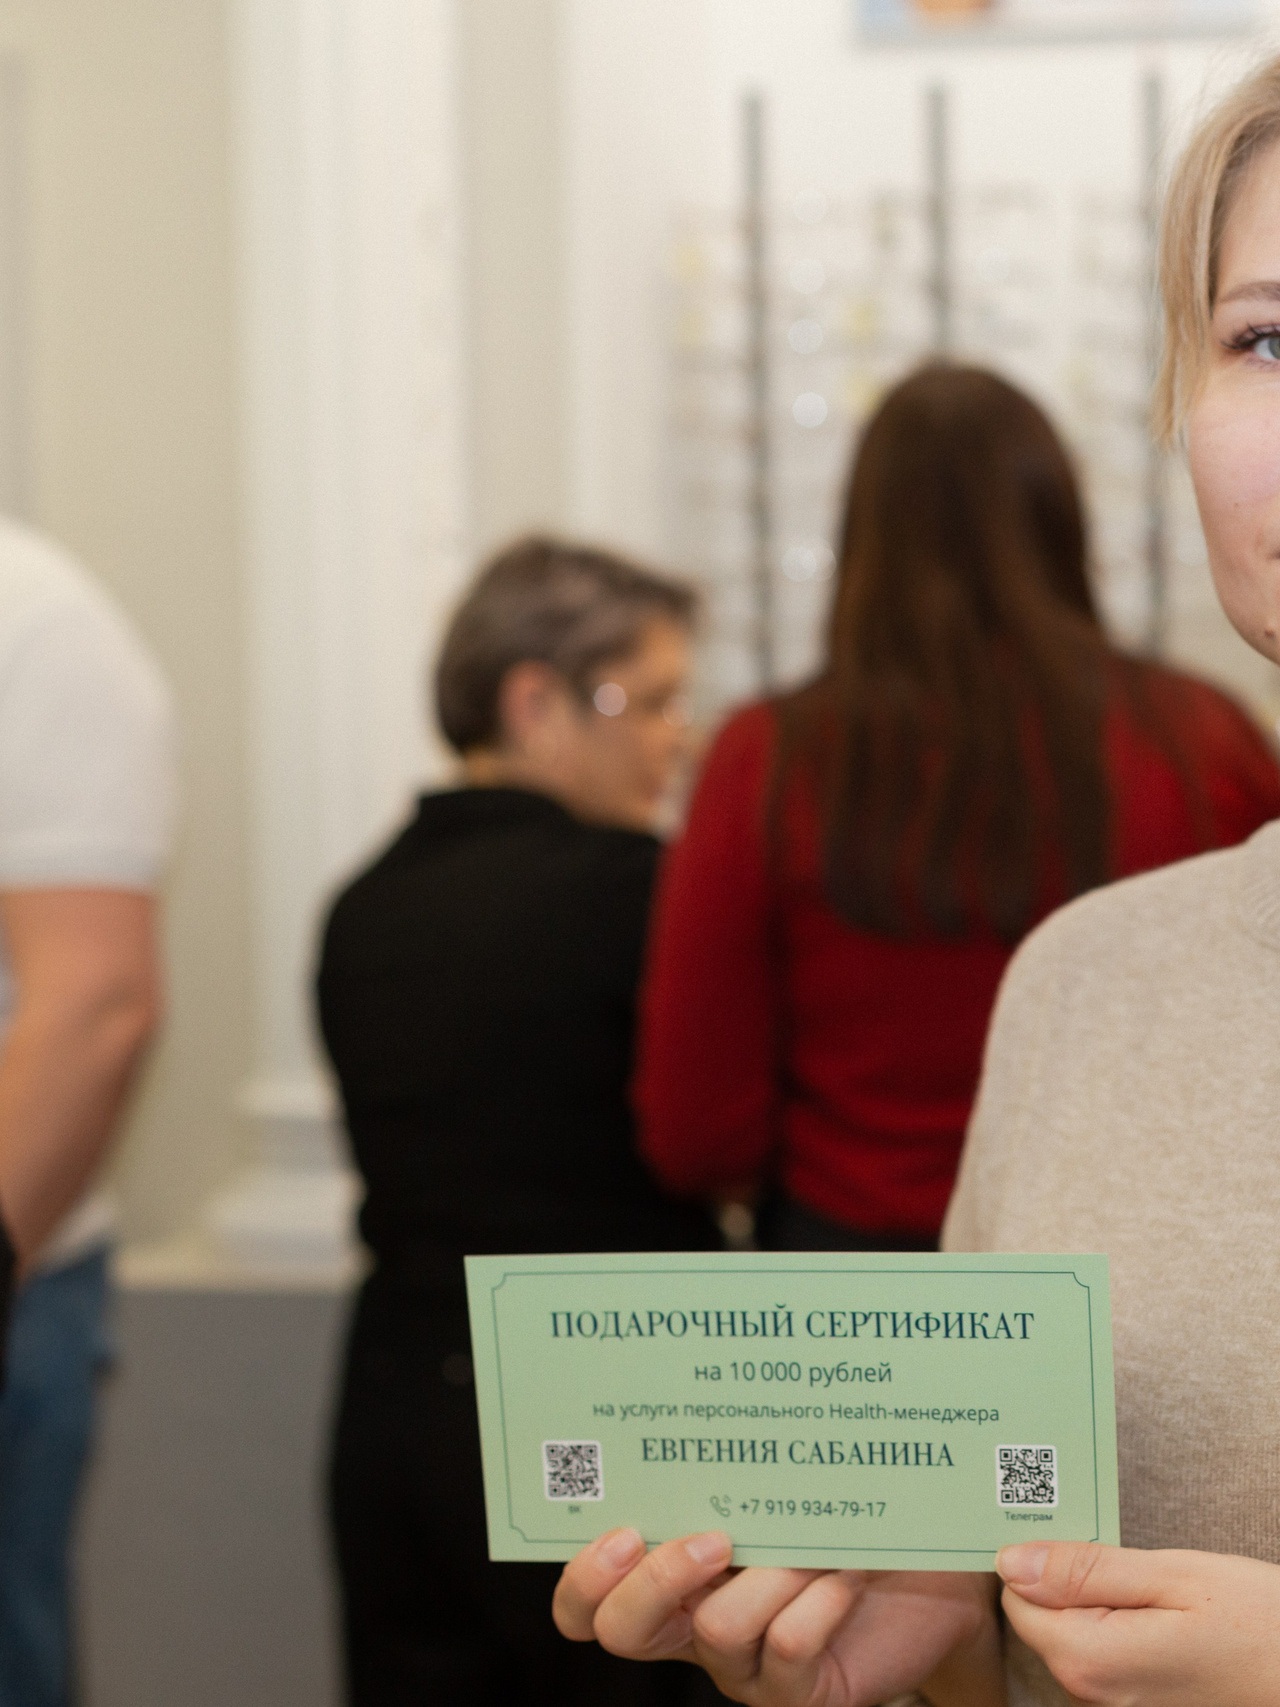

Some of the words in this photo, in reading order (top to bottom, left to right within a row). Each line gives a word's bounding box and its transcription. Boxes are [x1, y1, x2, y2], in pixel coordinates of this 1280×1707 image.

[551, 1303, 794, 1340] ПОДАРОЧНЫЙ
[806, 1311, 1035, 1340] СЕРТИФИКАТ
[695, 1366, 722, 1381] на
[809, 1361, 892, 1387] рублей
[593, 1404, 615, 1417] на
[621, 1404, 678, 1422] услуги
[684, 1404, 823, 1421] персонального
[830, 1404, 1000, 1425] Health-менеджера
[641, 1437, 778, 1464] ЕВГЕНИЯ
[788, 1440, 955, 1467] САБАНИНА
[740, 1500, 760, 1515] +7
[765, 1500, 796, 1516] 919
[801, 1501, 886, 1517] 934-79-17
[1004, 1511, 1053, 1521] Телеграм
